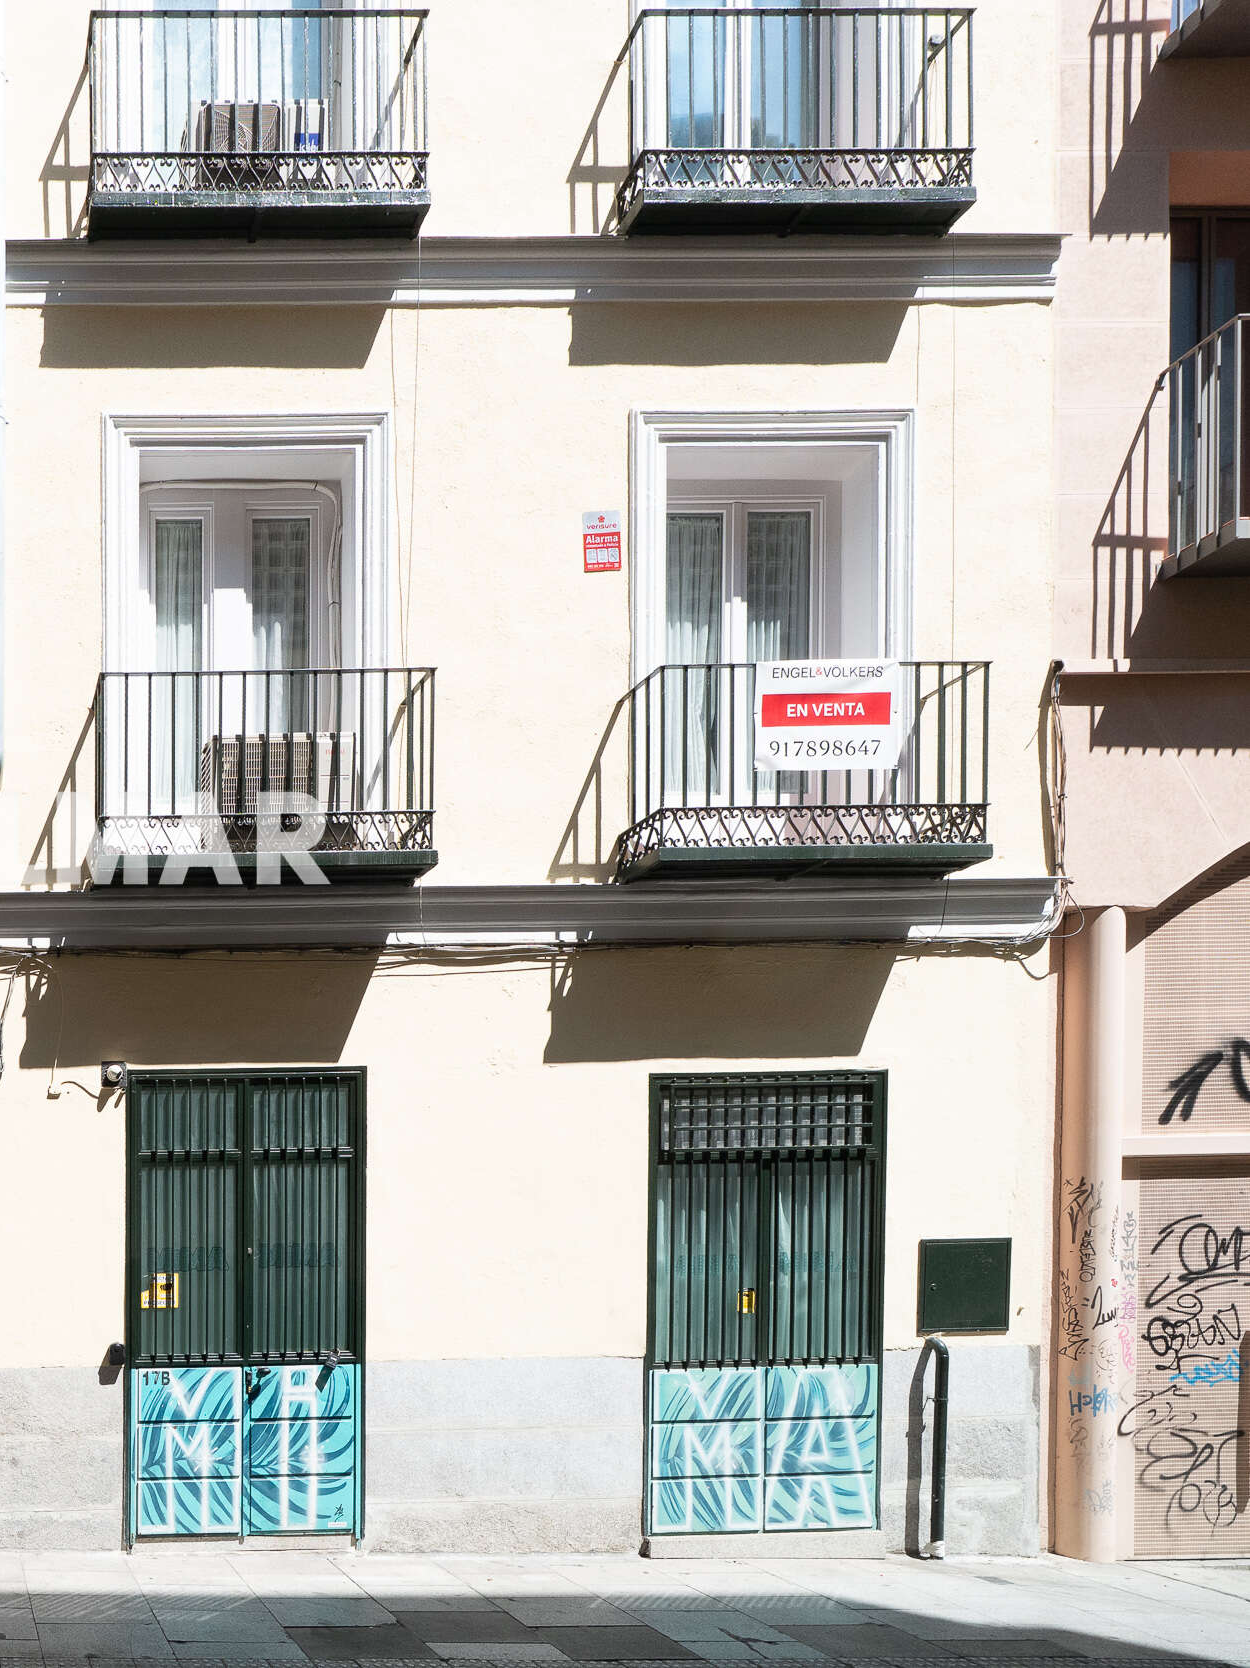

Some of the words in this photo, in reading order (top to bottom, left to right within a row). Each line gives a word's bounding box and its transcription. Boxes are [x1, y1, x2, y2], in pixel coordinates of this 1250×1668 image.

[586, 522, 618, 530] verisure
[585, 535, 619, 544] Alarma
[786, 703, 808, 717] EN
[811, 702, 866, 717] VENTA
[769, 739, 882, 757] 917898647
[142, 1370, 171, 1386] 17B
